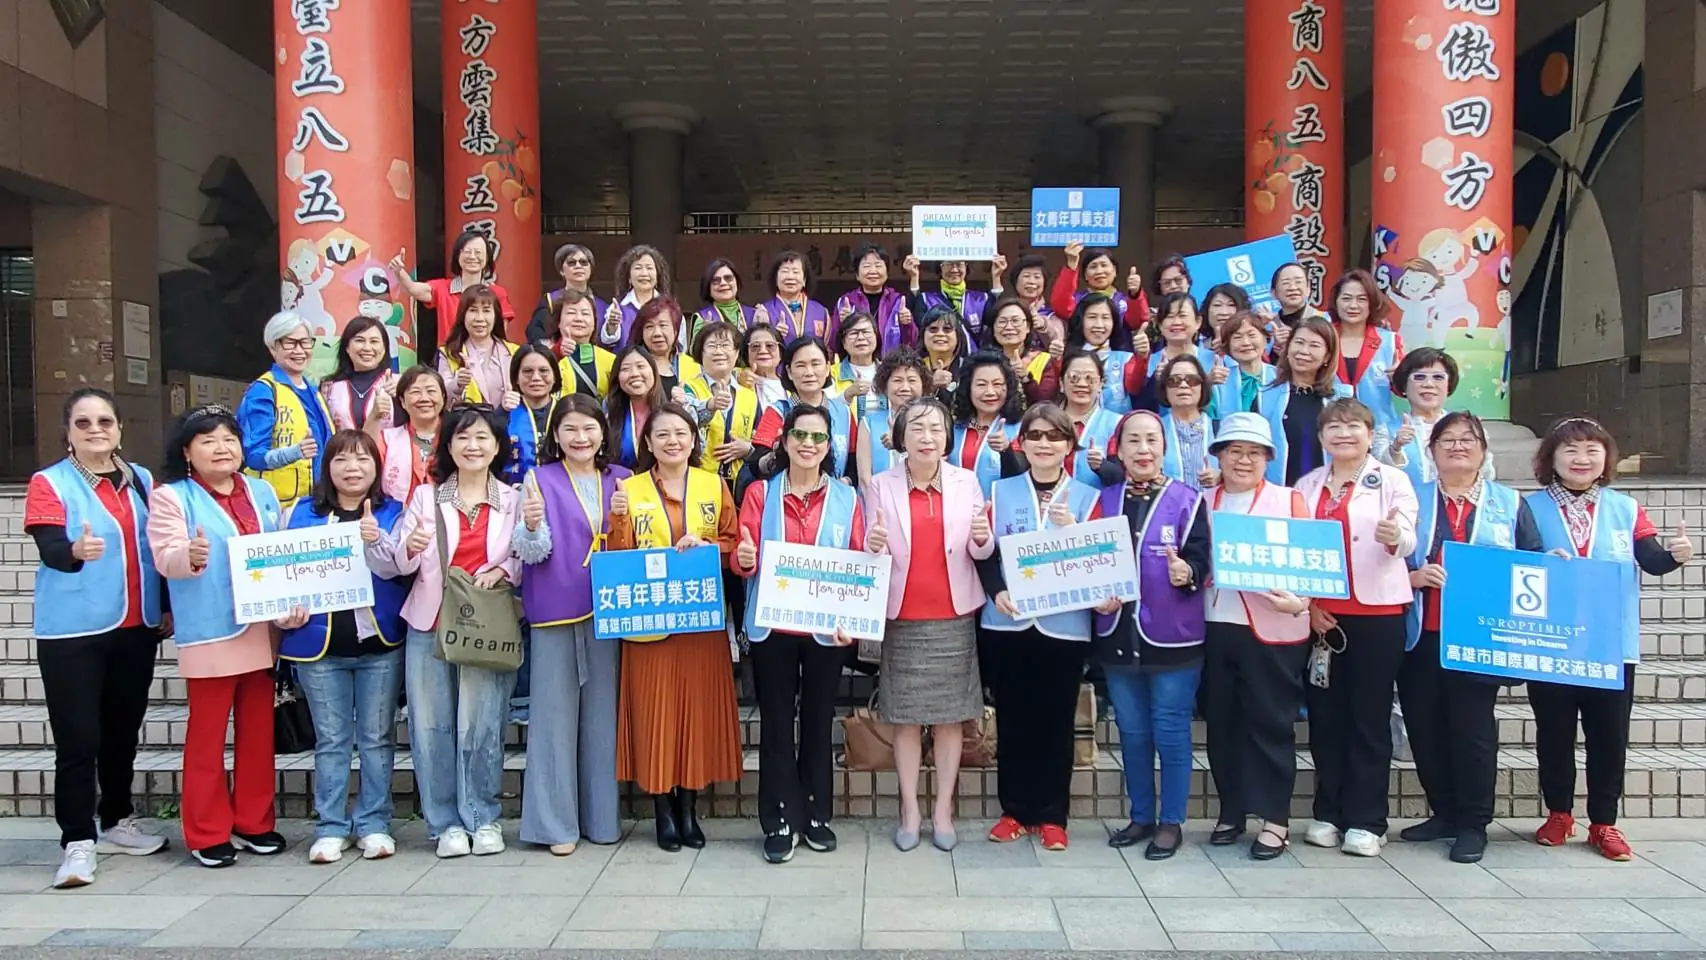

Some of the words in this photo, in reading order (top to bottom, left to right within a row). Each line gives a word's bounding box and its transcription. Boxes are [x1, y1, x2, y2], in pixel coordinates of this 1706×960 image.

[247, 543, 295, 559] DREAM
[300, 541, 311, 553] IT
[319, 538, 335, 549] BE
[340, 535, 352, 547] IT
[1017, 540, 1062, 557] DREAM
[1065, 537, 1077, 548] IT
[1085, 533, 1099, 544] BE
[1104, 531, 1116, 542] IT
[778, 554, 822, 570] DREAM
[826, 561, 838, 572] IT
[845, 563, 860, 575] BE
[865, 565, 877, 577] IT
[598, 577, 718, 611] 女青年事業支援
